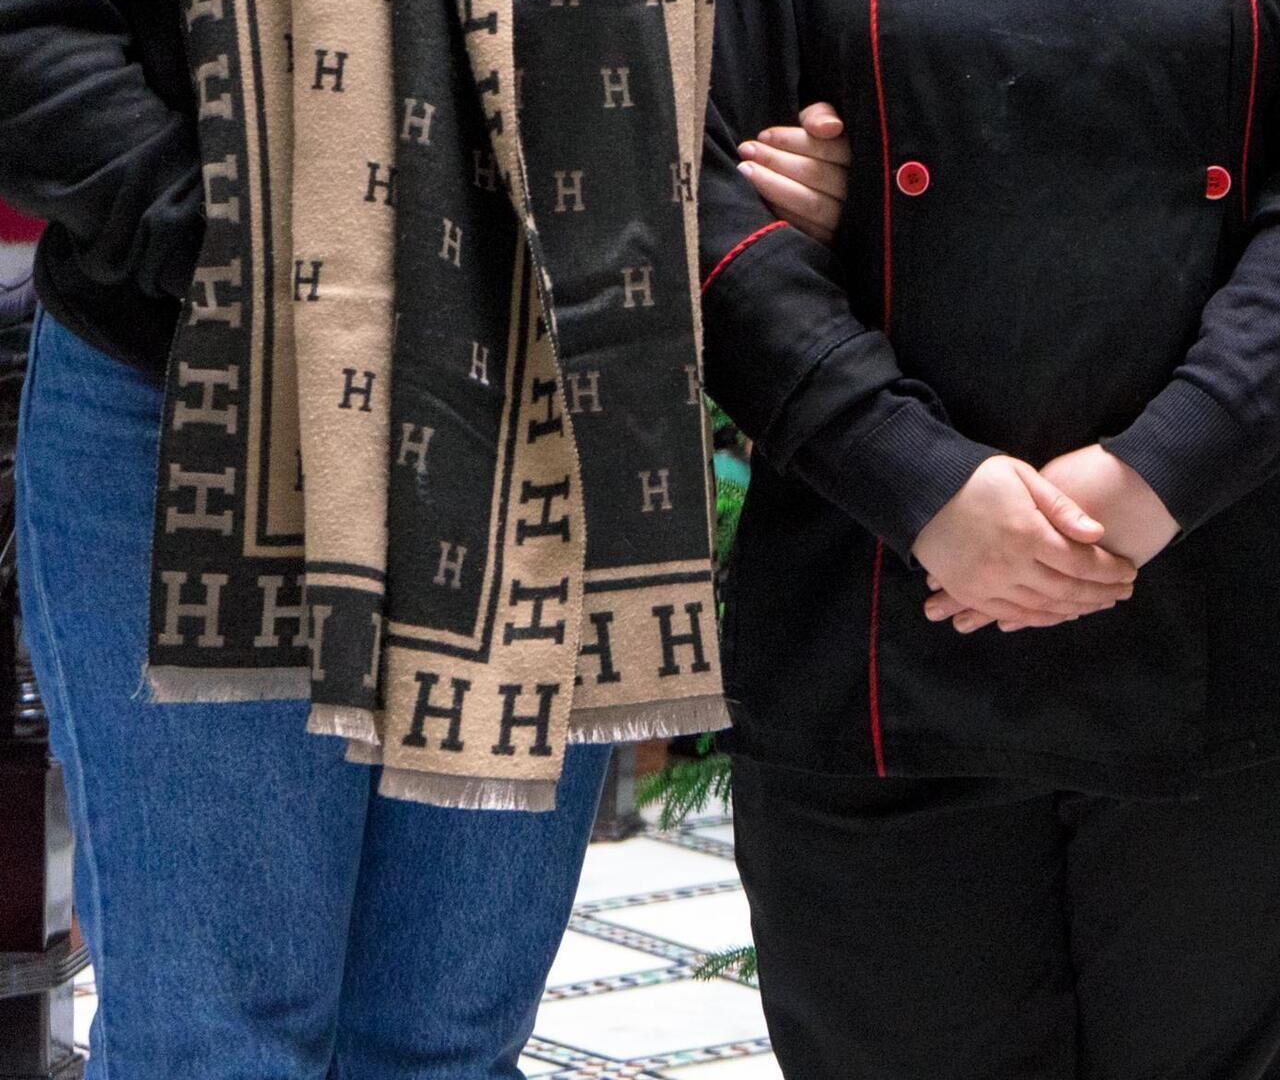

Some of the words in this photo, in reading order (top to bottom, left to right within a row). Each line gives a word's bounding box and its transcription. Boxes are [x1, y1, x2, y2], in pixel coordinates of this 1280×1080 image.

[311, 49, 348, 93] H
[600, 67, 635, 108] H
[401, 98, 437, 145] H
[364, 161, 398, 207] H
[554, 170, 586, 212] H
[439, 218, 463, 267] H
[293, 260, 324, 302] H
[621, 266, 656, 308] H
[468, 341, 490, 385] H
[339, 368, 376, 412] H
[567, 370, 603, 413] H
[397, 423, 435, 469] H
[166, 463, 235, 536] H
[638, 469, 673, 512] H
[433, 540, 468, 590] H
[158, 571, 228, 647] H
[503, 577, 569, 645] H
[652, 601, 711, 677] H
[402, 671, 471, 752] H
[492, 683, 560, 756] H
